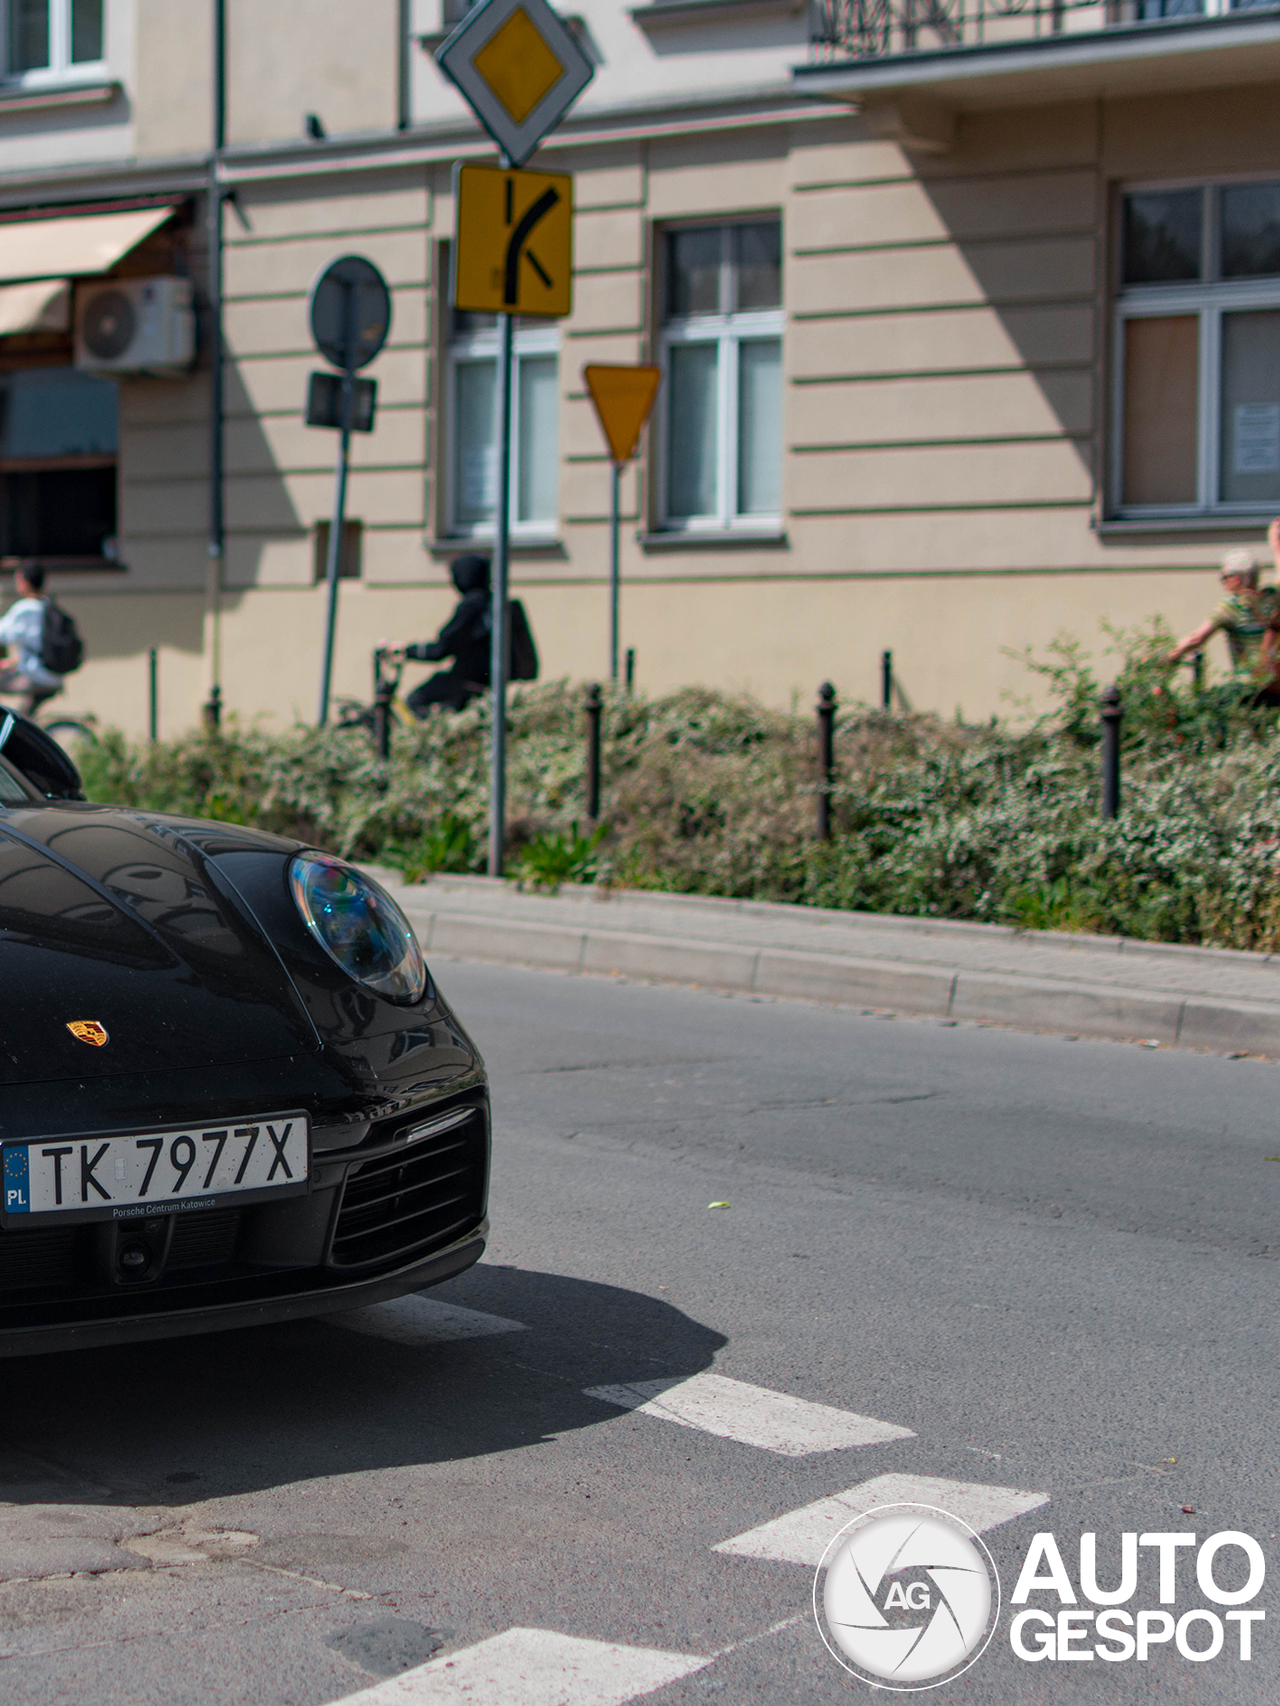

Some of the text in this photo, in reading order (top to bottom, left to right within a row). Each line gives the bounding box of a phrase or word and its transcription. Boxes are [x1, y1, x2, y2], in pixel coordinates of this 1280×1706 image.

[42, 1123, 293, 1205] TK 7977X
[7, 1189, 27, 1206] PL
[113, 1198, 216, 1218] Porsche Centrum Katowice
